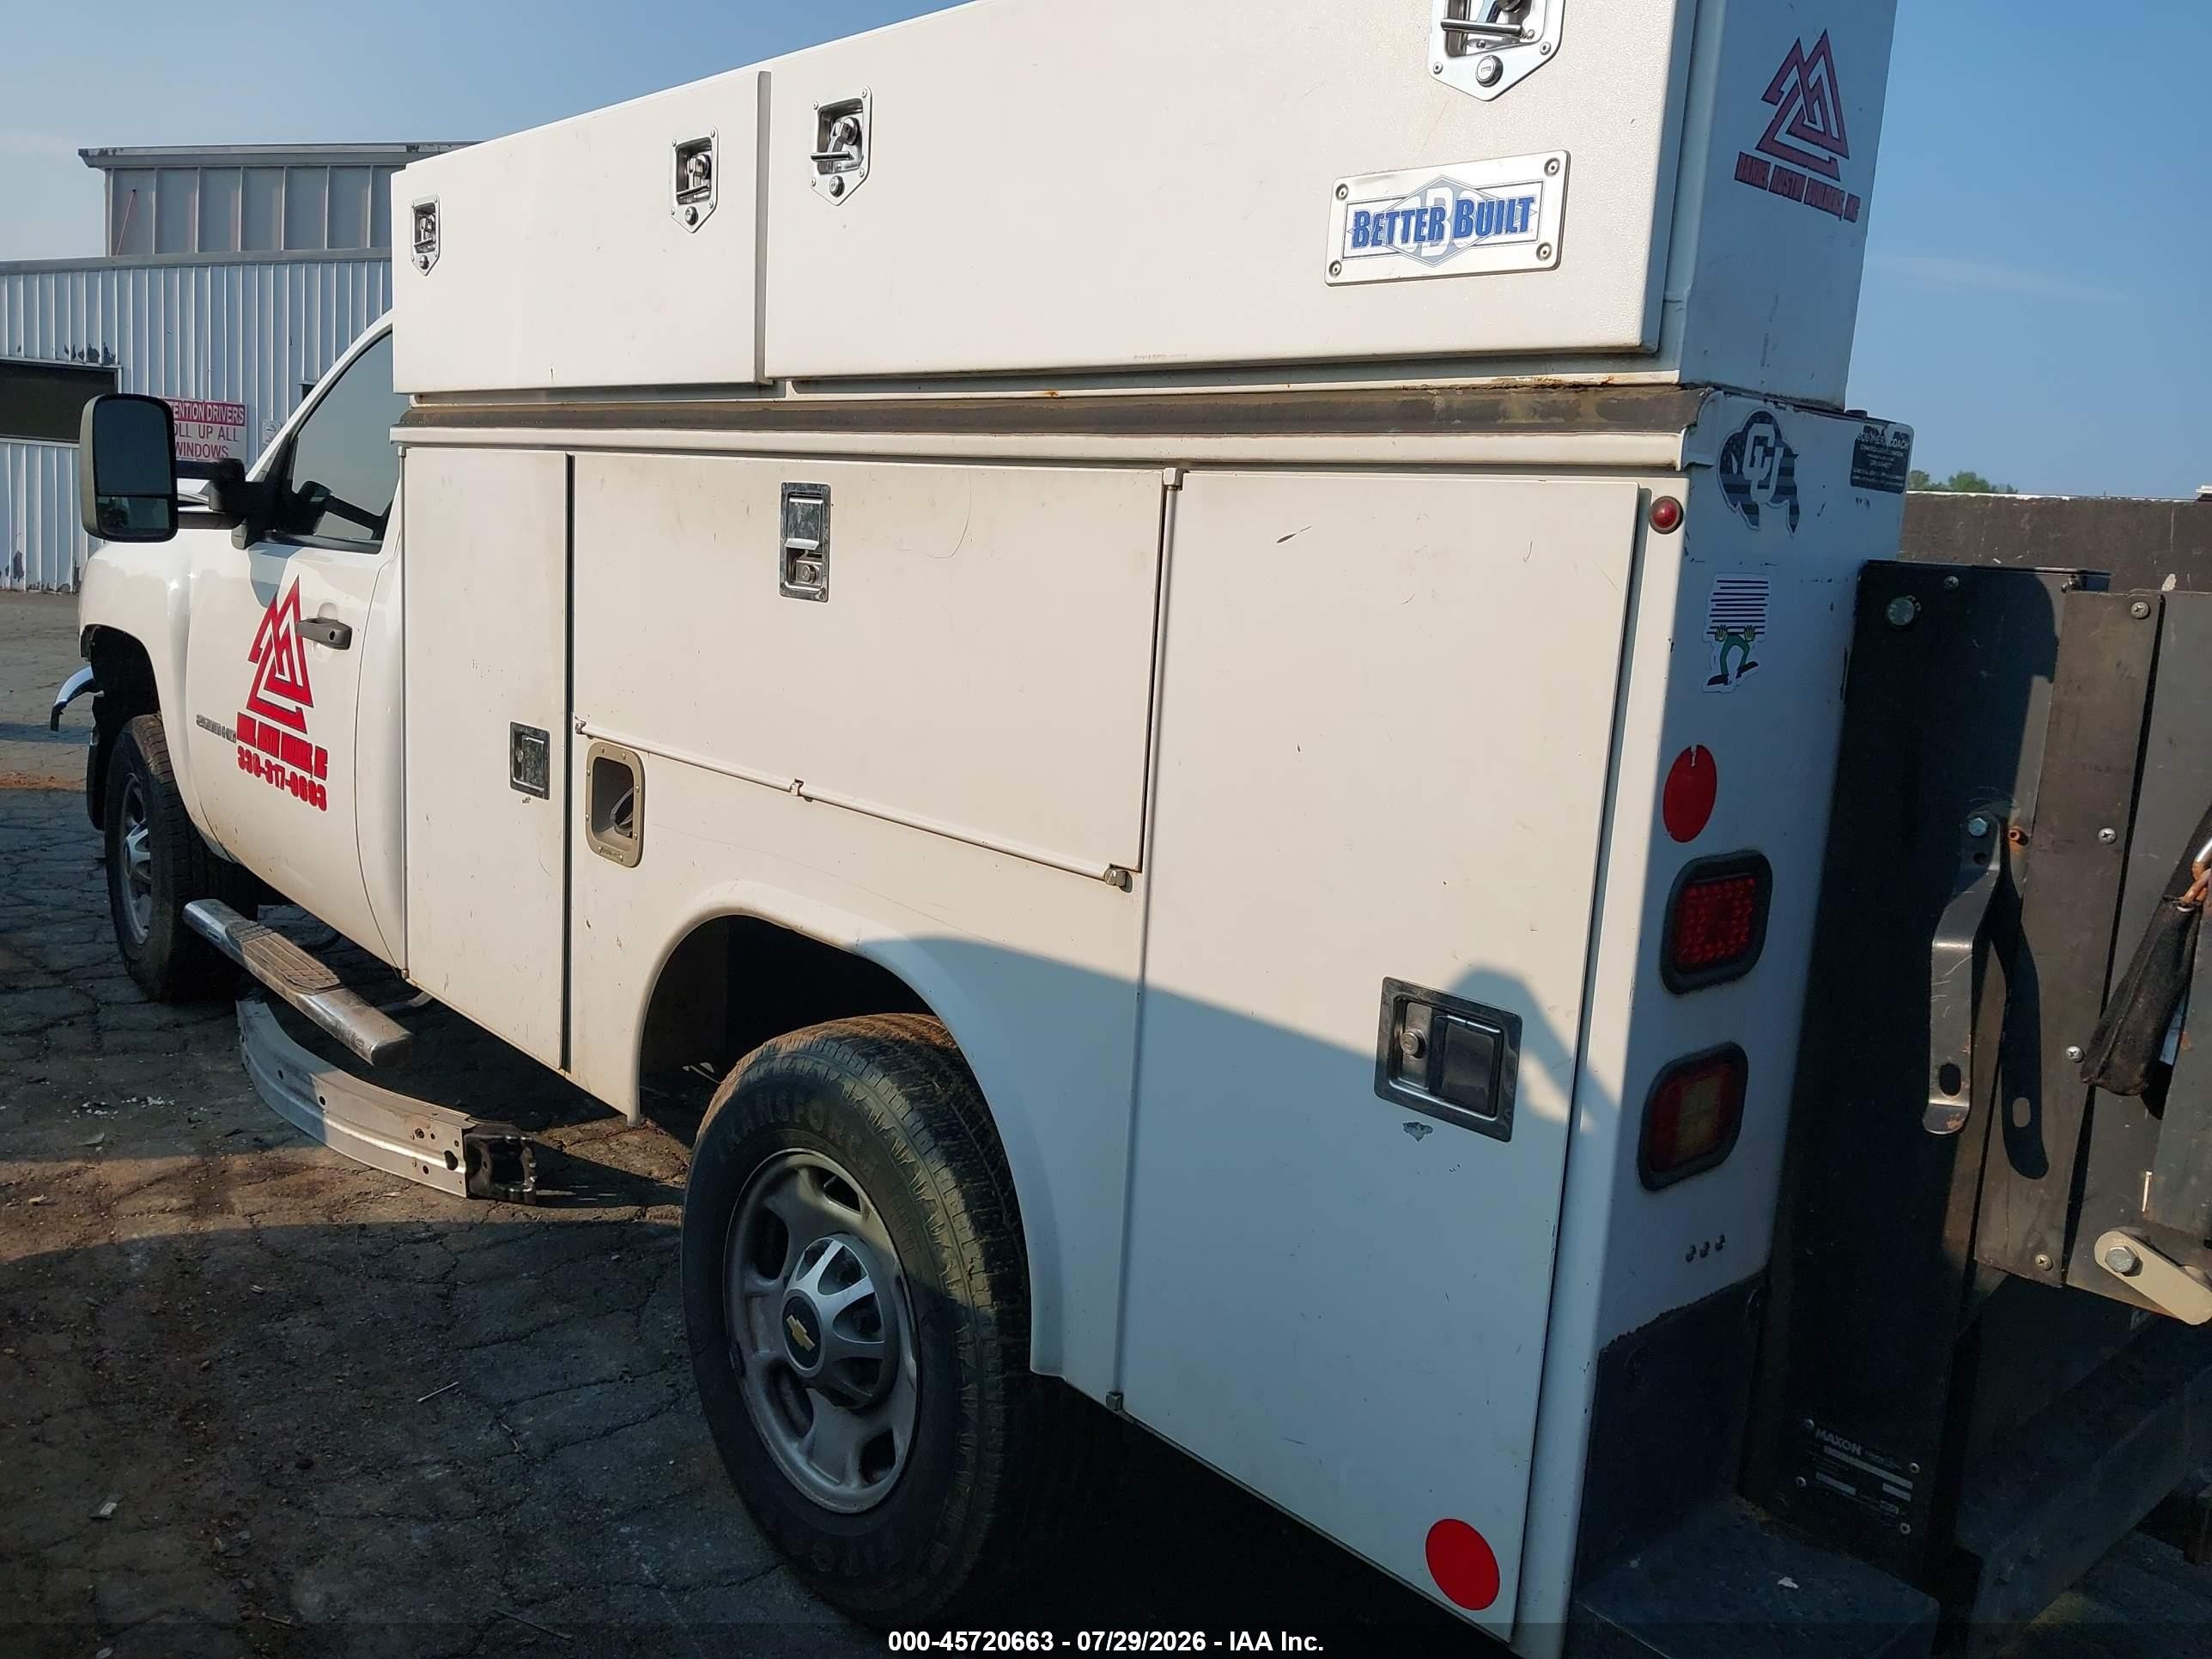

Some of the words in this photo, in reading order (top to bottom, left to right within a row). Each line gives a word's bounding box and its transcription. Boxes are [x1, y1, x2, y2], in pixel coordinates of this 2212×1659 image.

[1351, 207, 1446, 250] BETTER
[1453, 196, 1535, 239] BUILT
[173, 402, 205, 422] ENTION
[206, 404, 244, 424] DRIVERS
[198, 424, 213, 440] UP
[218, 426, 240, 442] ALL
[1814, 1428, 1862, 1455] MAXON
